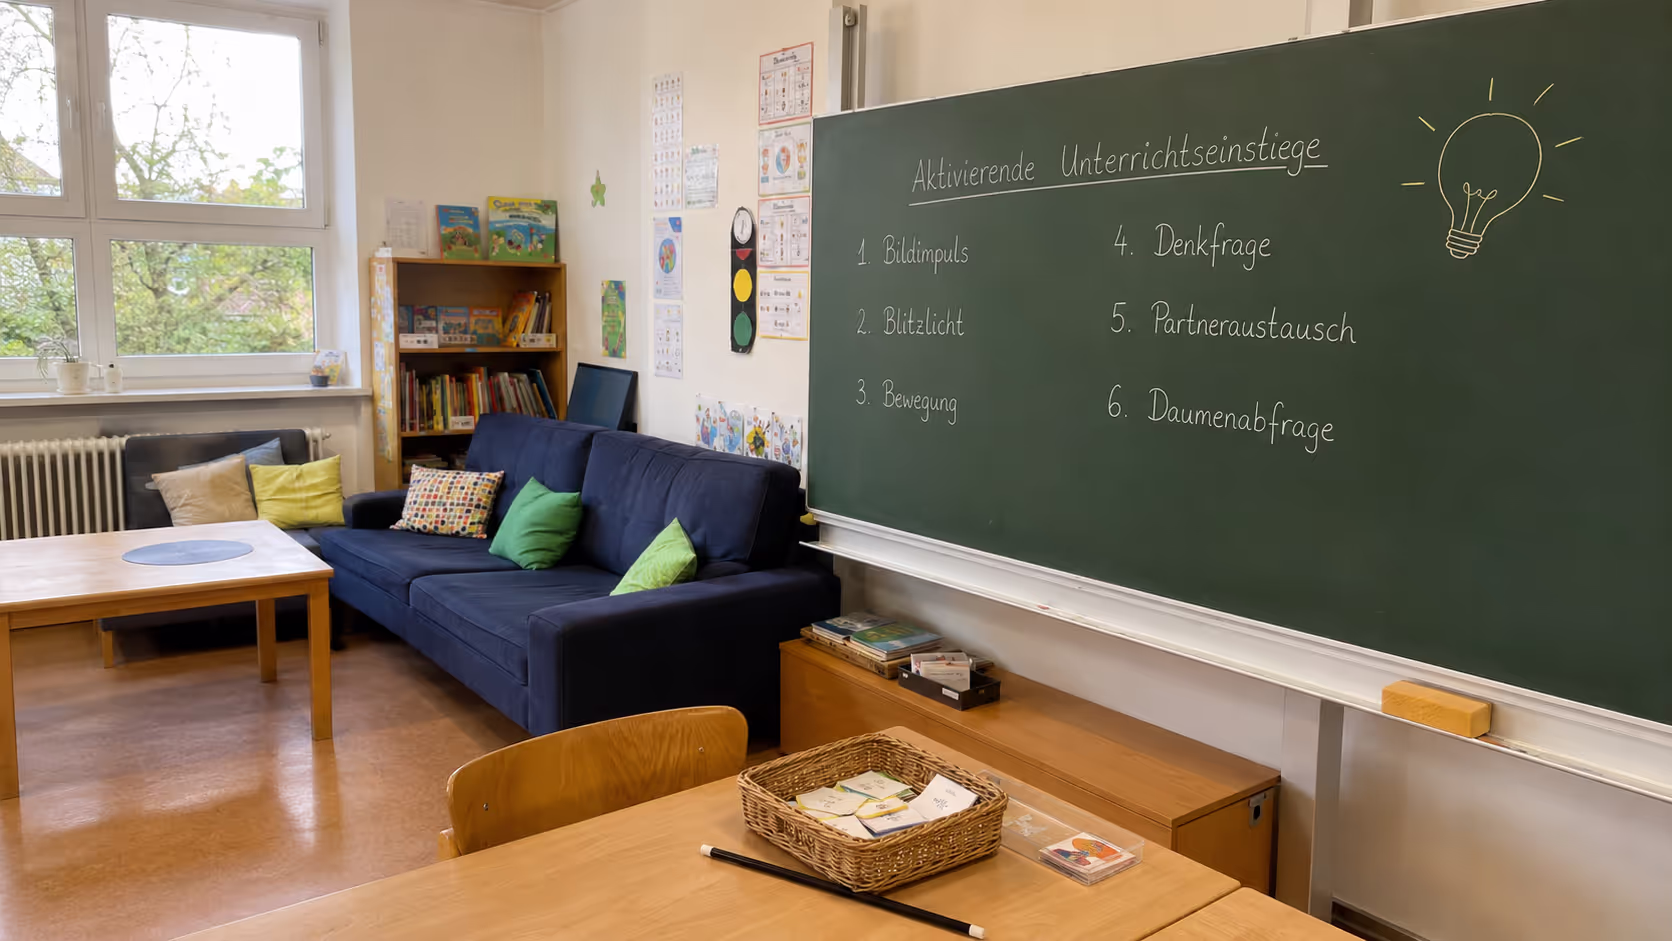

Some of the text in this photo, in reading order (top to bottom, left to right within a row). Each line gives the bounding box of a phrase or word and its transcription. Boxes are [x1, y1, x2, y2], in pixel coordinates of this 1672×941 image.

[911, 125, 1322, 193] Aktivierende Unterrichtseinstiege
[857, 234, 969, 275] 1. Bildimpuls
[1113, 221, 1272, 272] 4. Denkfrage
[856, 305, 965, 337] 2. Blitzlicht
[1110, 300, 1357, 345] 5. Partneraustausch
[855, 378, 958, 426] 3. Bewegung
[1107, 383, 1335, 454] 6. Daumenabfrage
